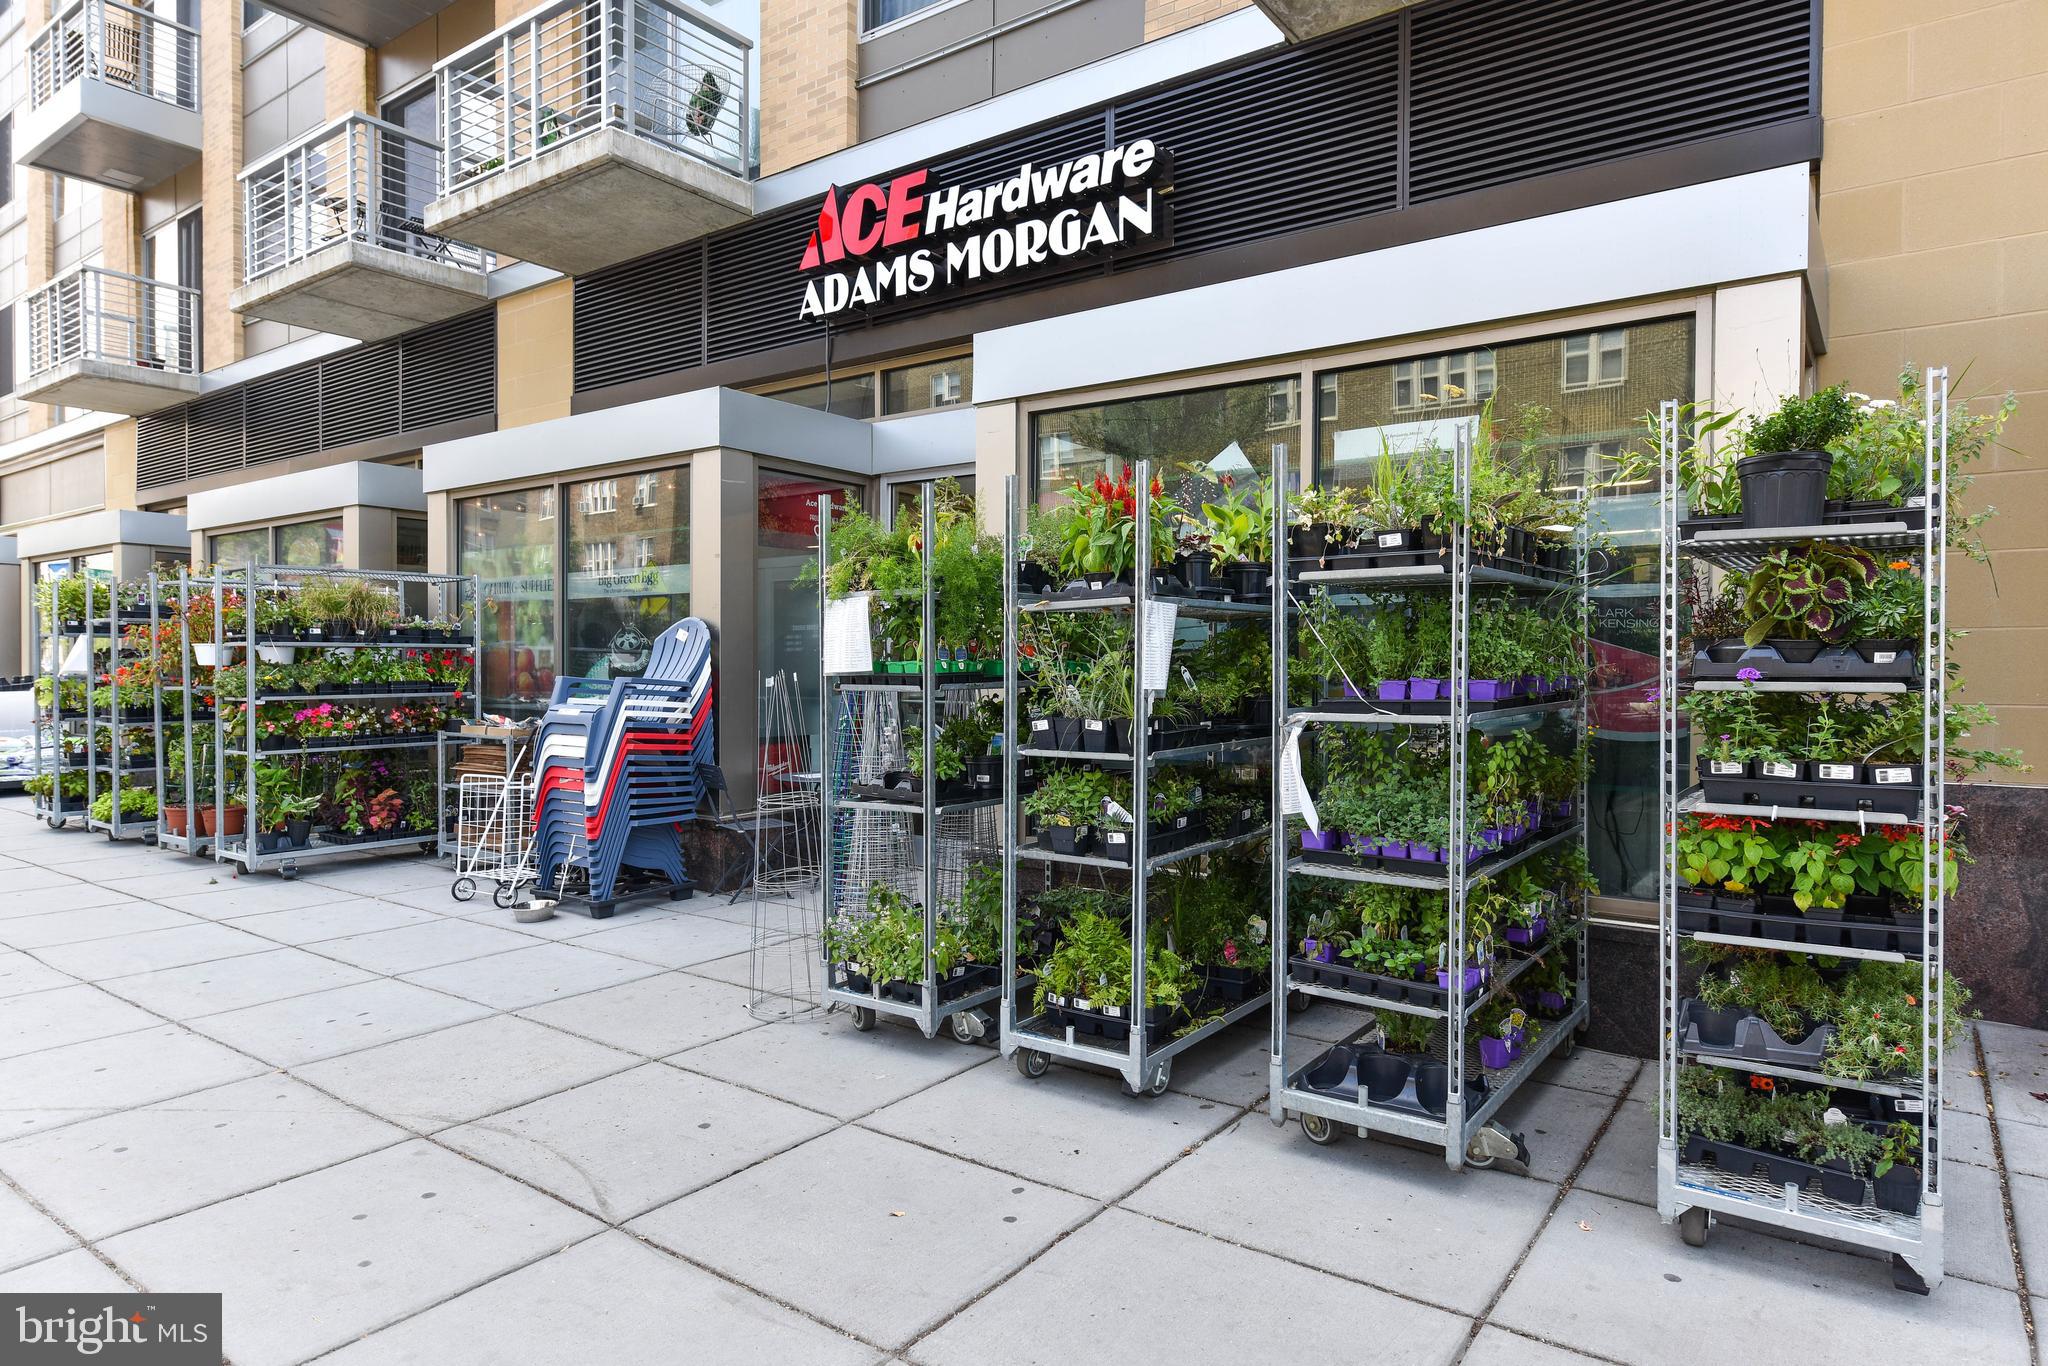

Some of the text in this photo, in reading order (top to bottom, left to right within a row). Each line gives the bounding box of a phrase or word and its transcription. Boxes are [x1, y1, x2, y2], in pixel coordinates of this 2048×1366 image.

[799, 138, 1156, 270] ACE Hardware
[799, 187, 1153, 321] ADAMS MORGAN
[805, 499, 818, 508] Ace
[520, 578, 555, 593] SUPPLIE
[597, 570, 659, 588] Big Green Egg
[1599, 618, 1660, 629] KENSING
